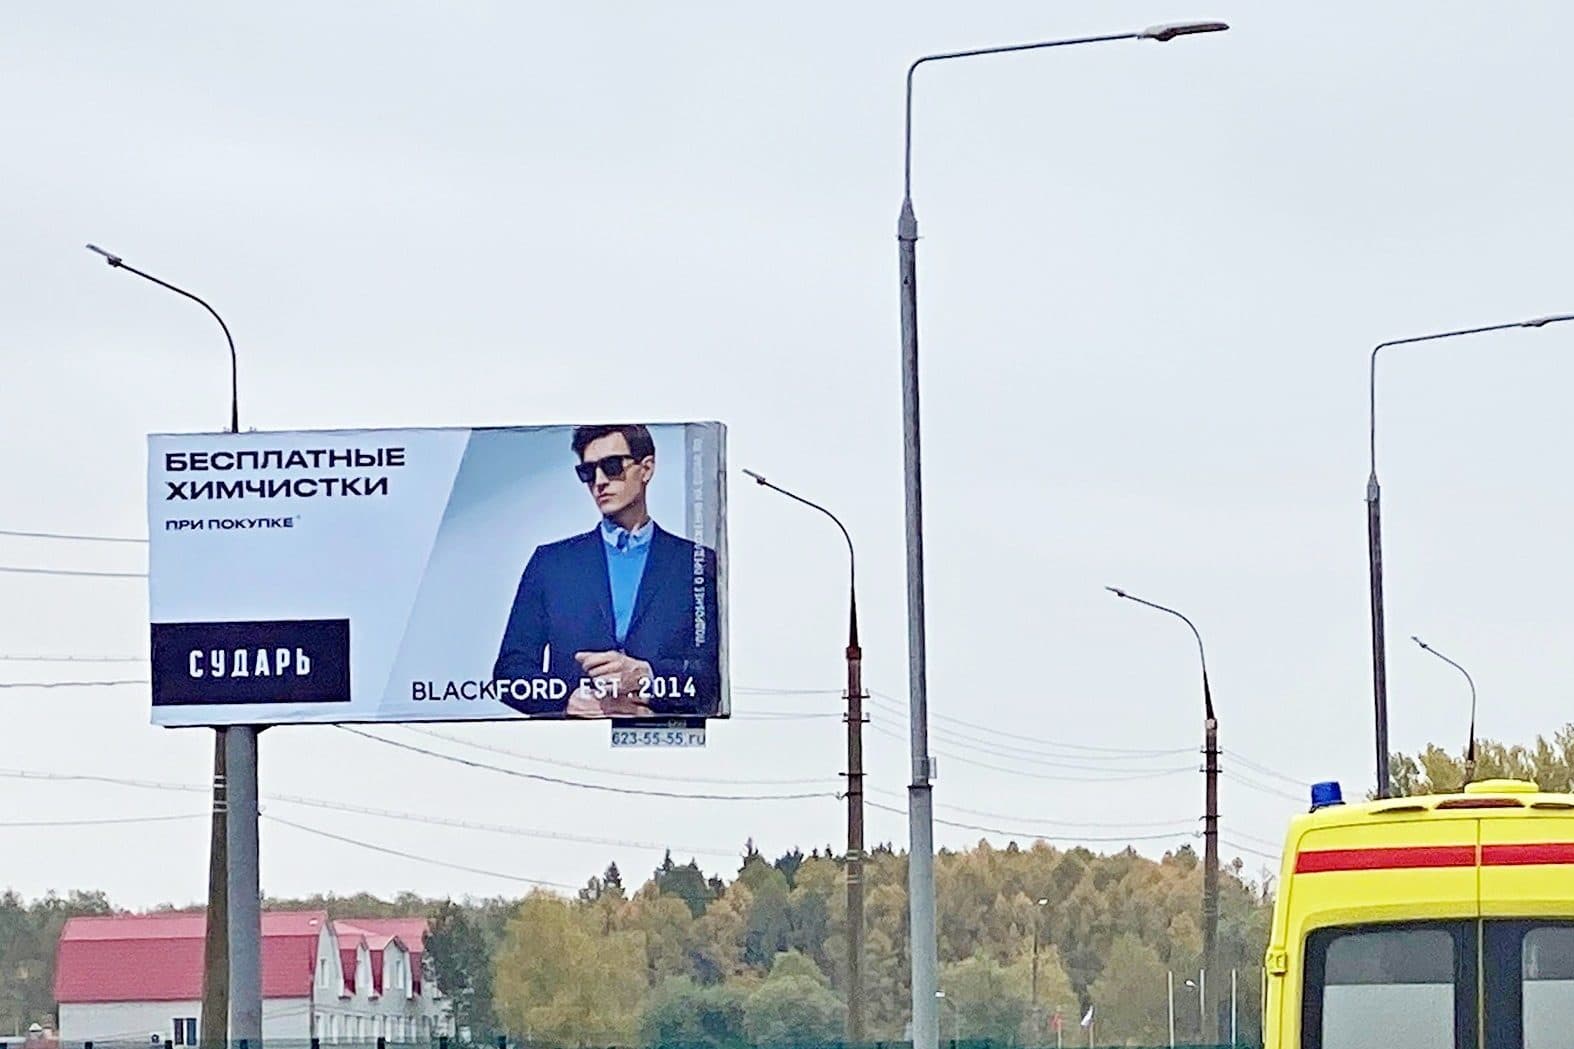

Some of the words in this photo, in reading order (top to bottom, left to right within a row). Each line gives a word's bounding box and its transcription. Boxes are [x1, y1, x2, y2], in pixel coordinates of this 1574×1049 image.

[165, 447, 406, 472] БЕСПЛАТНЫЕ
[165, 477, 389, 501] ХИМЧИСТКИ
[165, 519, 204, 531] ПРИ
[188, 647, 311, 678] СУДАРЬ
[411, 678, 568, 701] BLACKFORD
